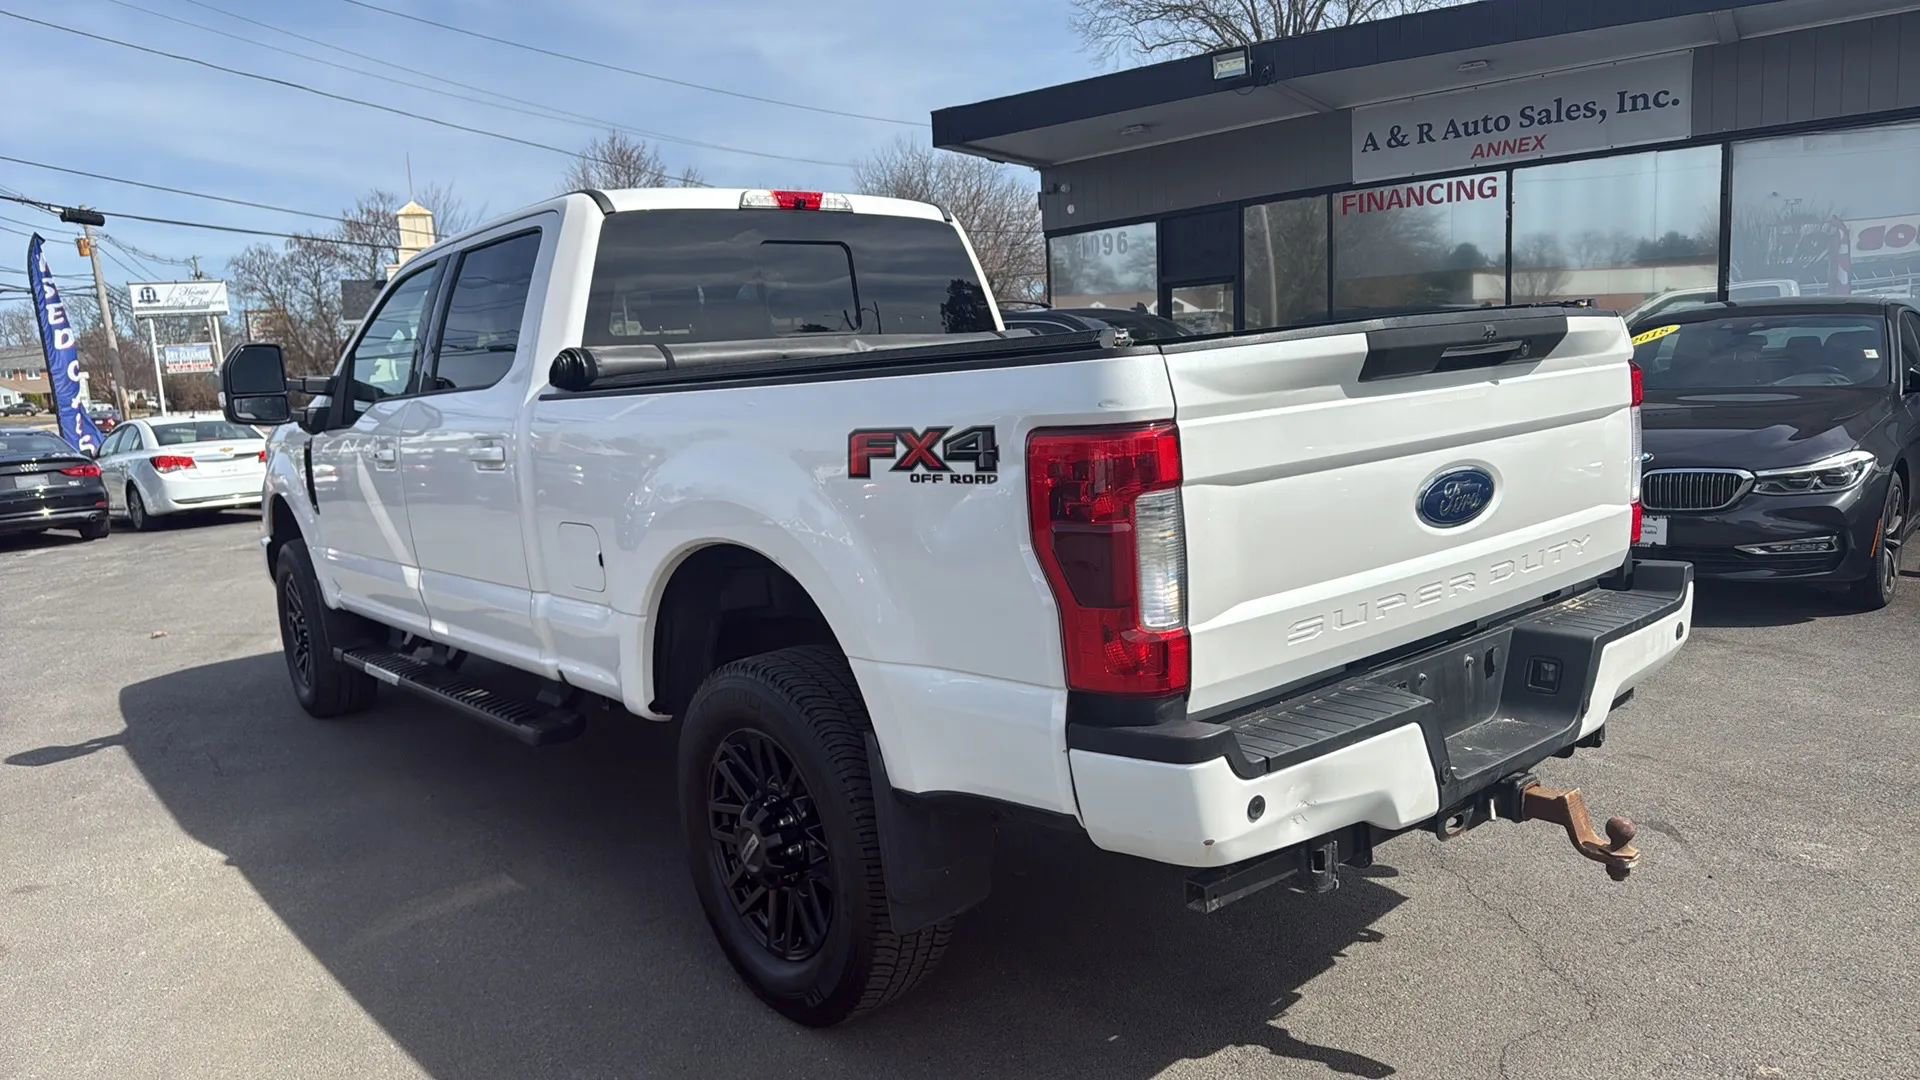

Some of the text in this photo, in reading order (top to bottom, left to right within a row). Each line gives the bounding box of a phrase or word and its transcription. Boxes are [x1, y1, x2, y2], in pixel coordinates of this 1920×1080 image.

[1361, 89, 1680, 153] A & R Auto Sales, Inc.
[1470, 134, 1547, 160] ANNEX
[1342, 176, 1498, 215] FINANCING
[848, 425, 1000, 479] FX4
[910, 474, 998, 484] OFF ROAD
[1440, 480, 1482, 516] Ford
[1287, 534, 1591, 646] SUPER DUTY
